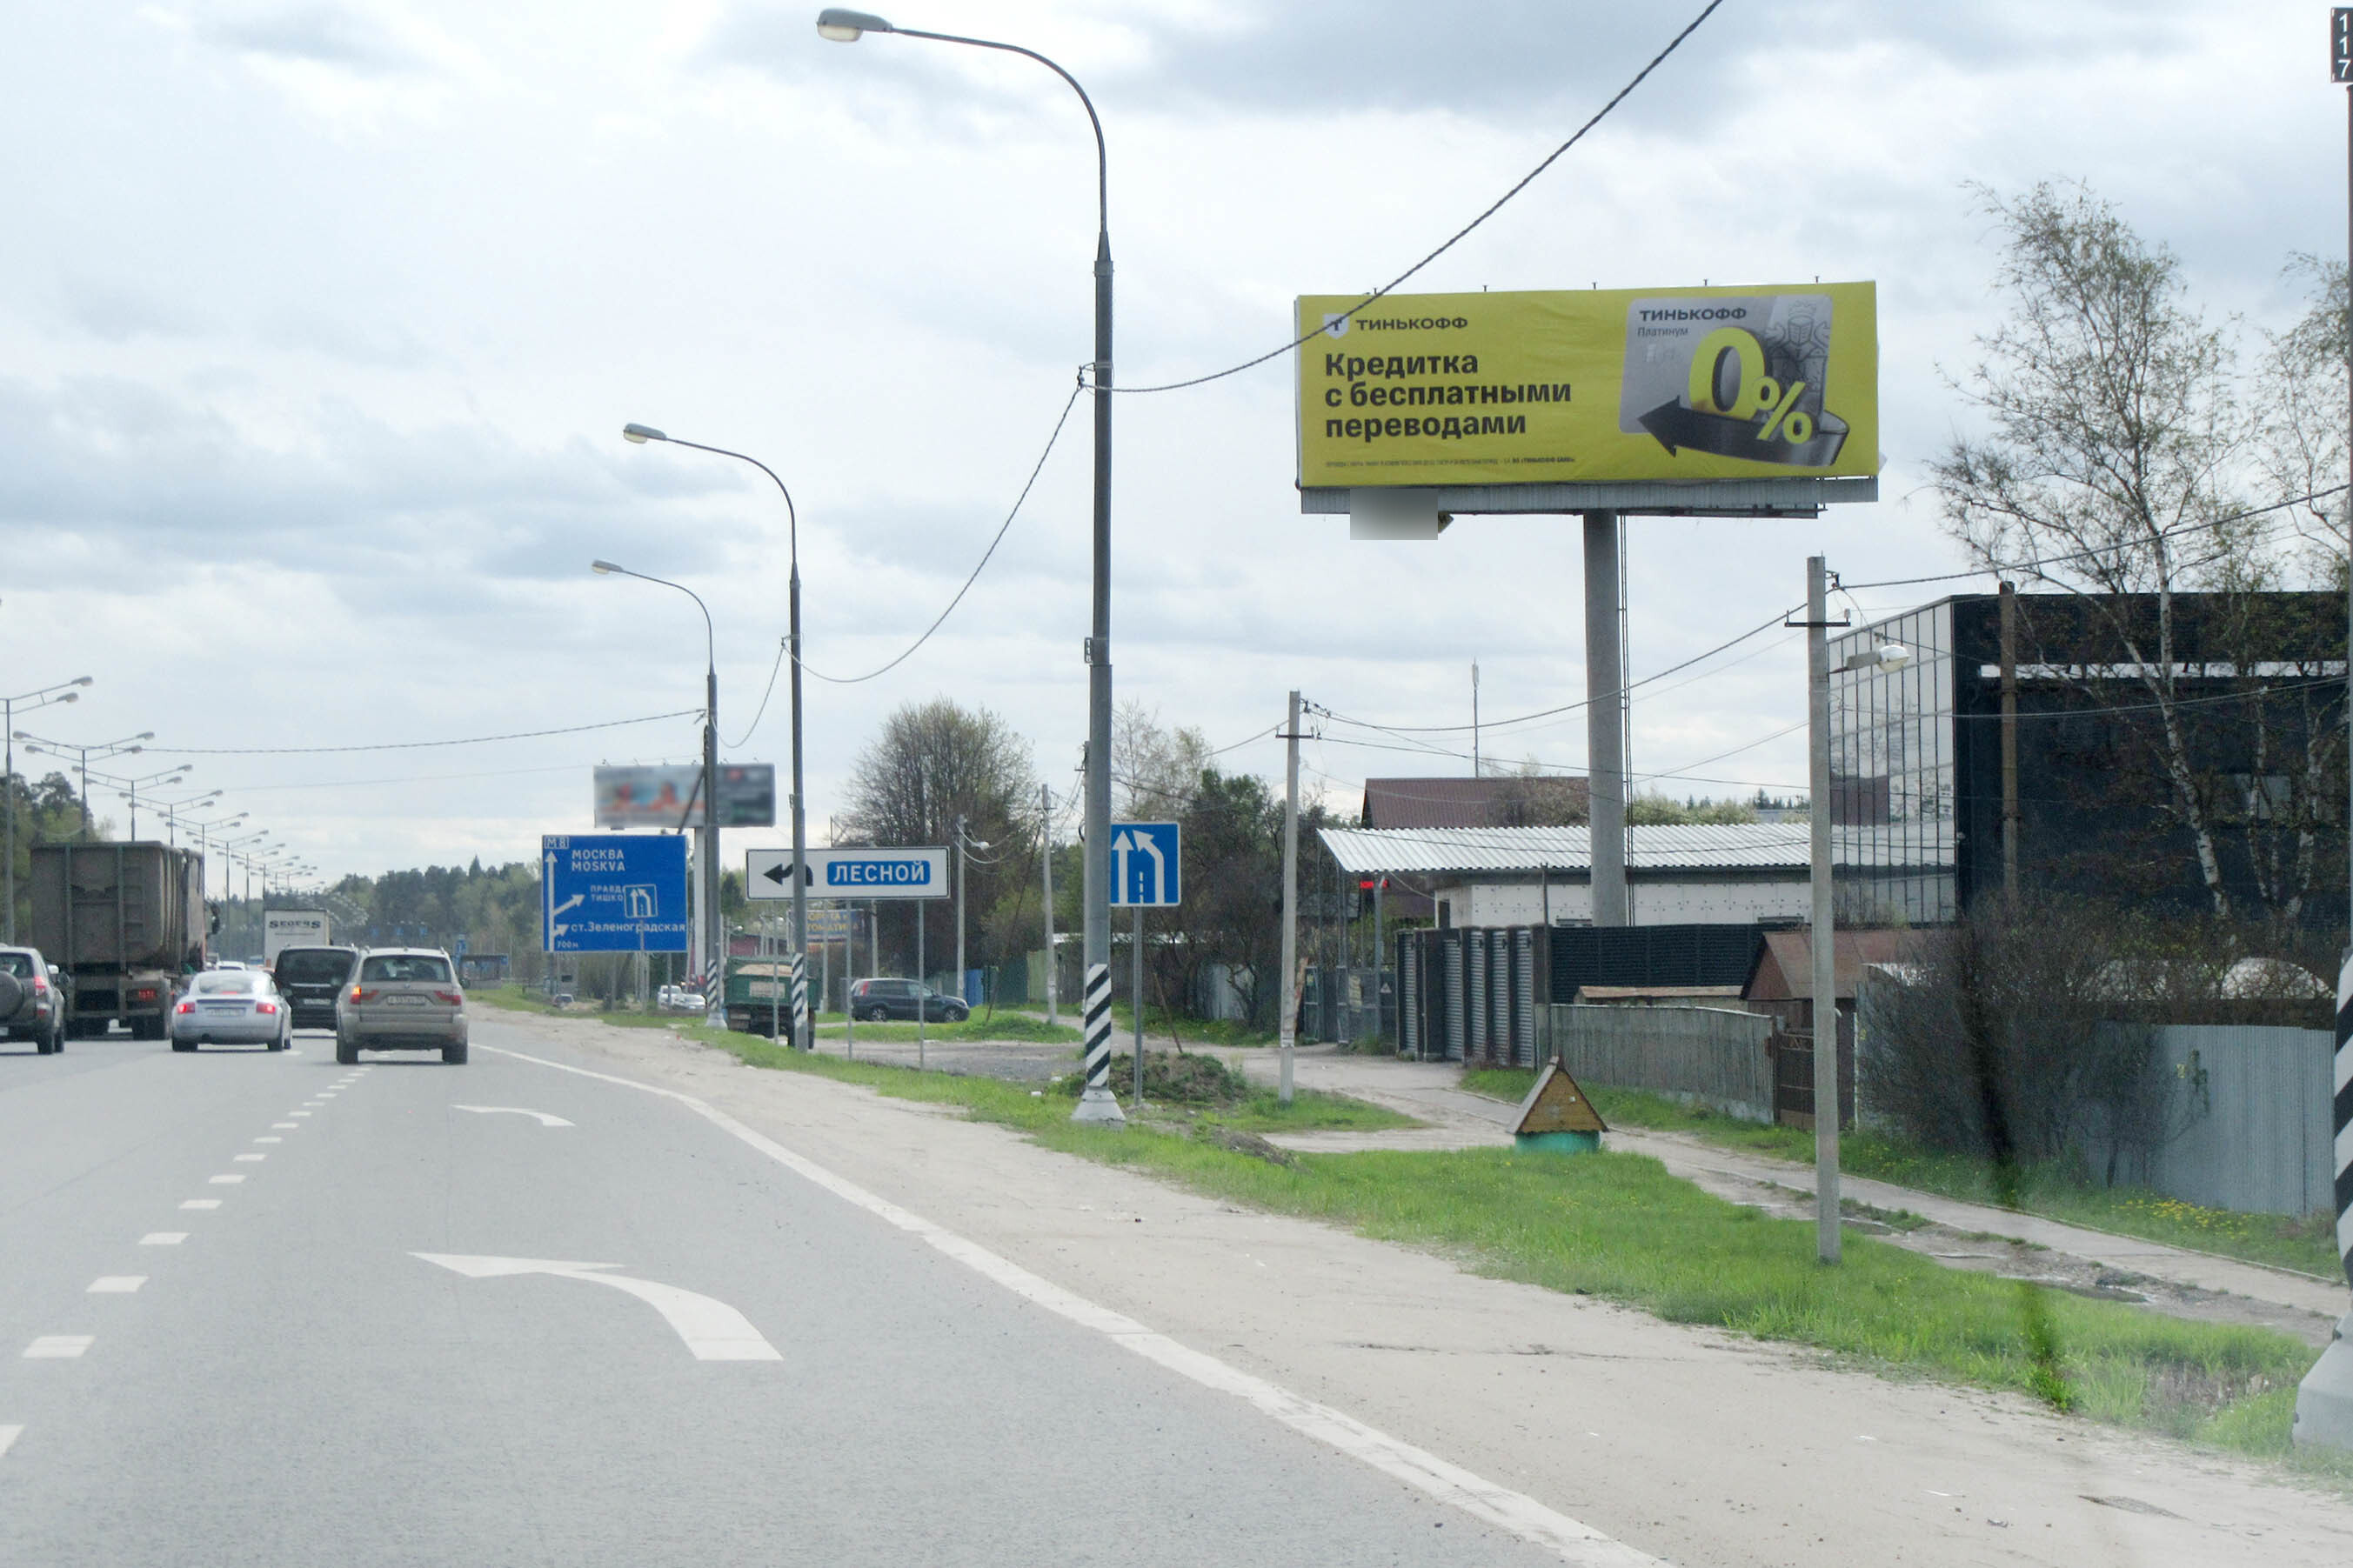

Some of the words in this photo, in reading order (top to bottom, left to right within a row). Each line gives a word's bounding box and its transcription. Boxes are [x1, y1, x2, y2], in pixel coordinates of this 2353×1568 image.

[2337, 13, 2352, 78] 117
[1355, 317, 1468, 330] ТИНЬКОФФ
[1640, 307, 1747, 322] ТИНЬКОФФ
[1637, 326, 1689, 338] Платинум
[1325, 352, 1479, 382] Кредитка
[1325, 387, 1342, 407] с
[1350, 381, 1572, 407] бесплатными
[1325, 415, 1527, 443] переводами
[572, 850, 625, 860] МОСКВА
[572, 860, 626, 871] MOSKVA
[833, 860, 925, 883] ЛЕСНОЙ
